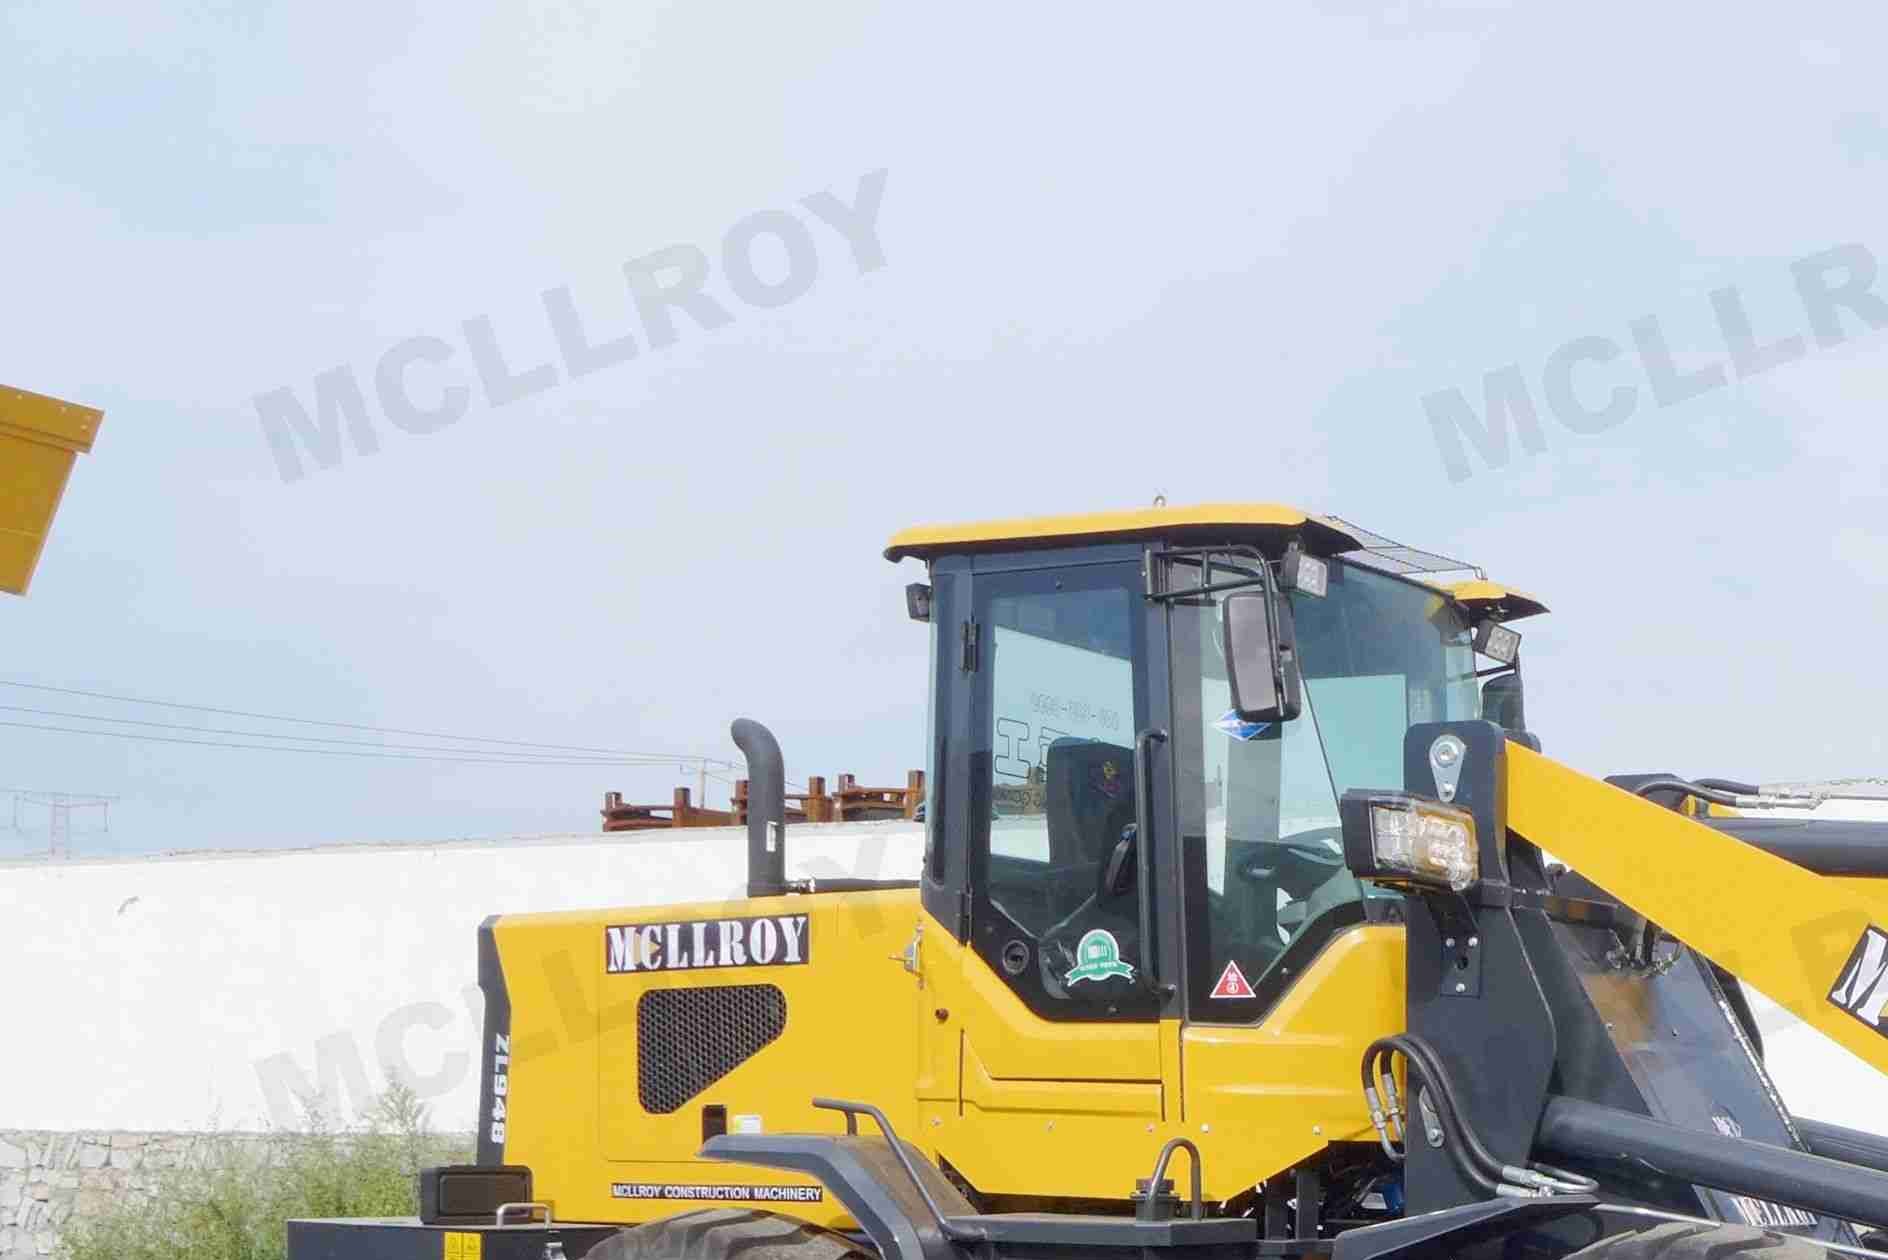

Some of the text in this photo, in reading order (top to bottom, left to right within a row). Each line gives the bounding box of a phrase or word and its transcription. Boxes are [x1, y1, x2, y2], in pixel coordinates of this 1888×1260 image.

[606, 916, 808, 973] MCLLROY
[612, 1184, 821, 1201] MCLLROY CONSTRUCTION MACHINERY
